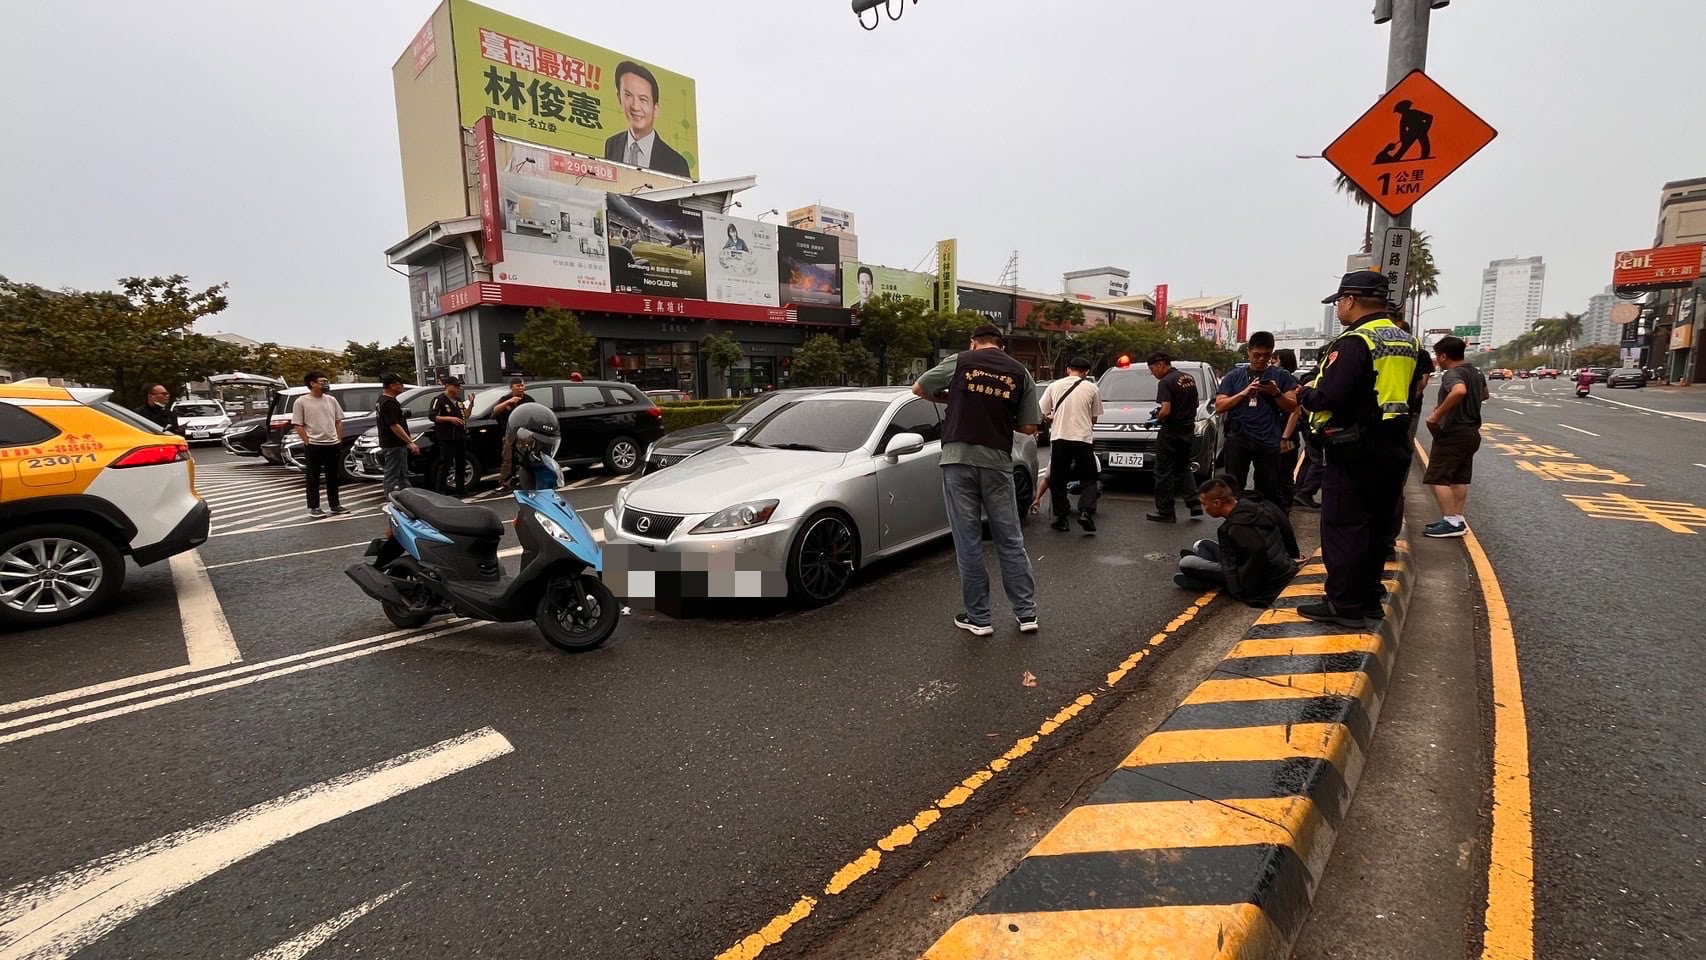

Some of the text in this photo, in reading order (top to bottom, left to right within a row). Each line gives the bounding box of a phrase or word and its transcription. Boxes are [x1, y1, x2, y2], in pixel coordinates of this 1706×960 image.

[480, 28, 601, 91] 臺南最好!!
[484, 65, 603, 129] 林俊憲
[1377, 169, 1424, 196] 1 公里
[1396, 183, 1420, 194] KM
[643, 278, 656, 286] Neo
[28, 453, 97, 468] 23071
